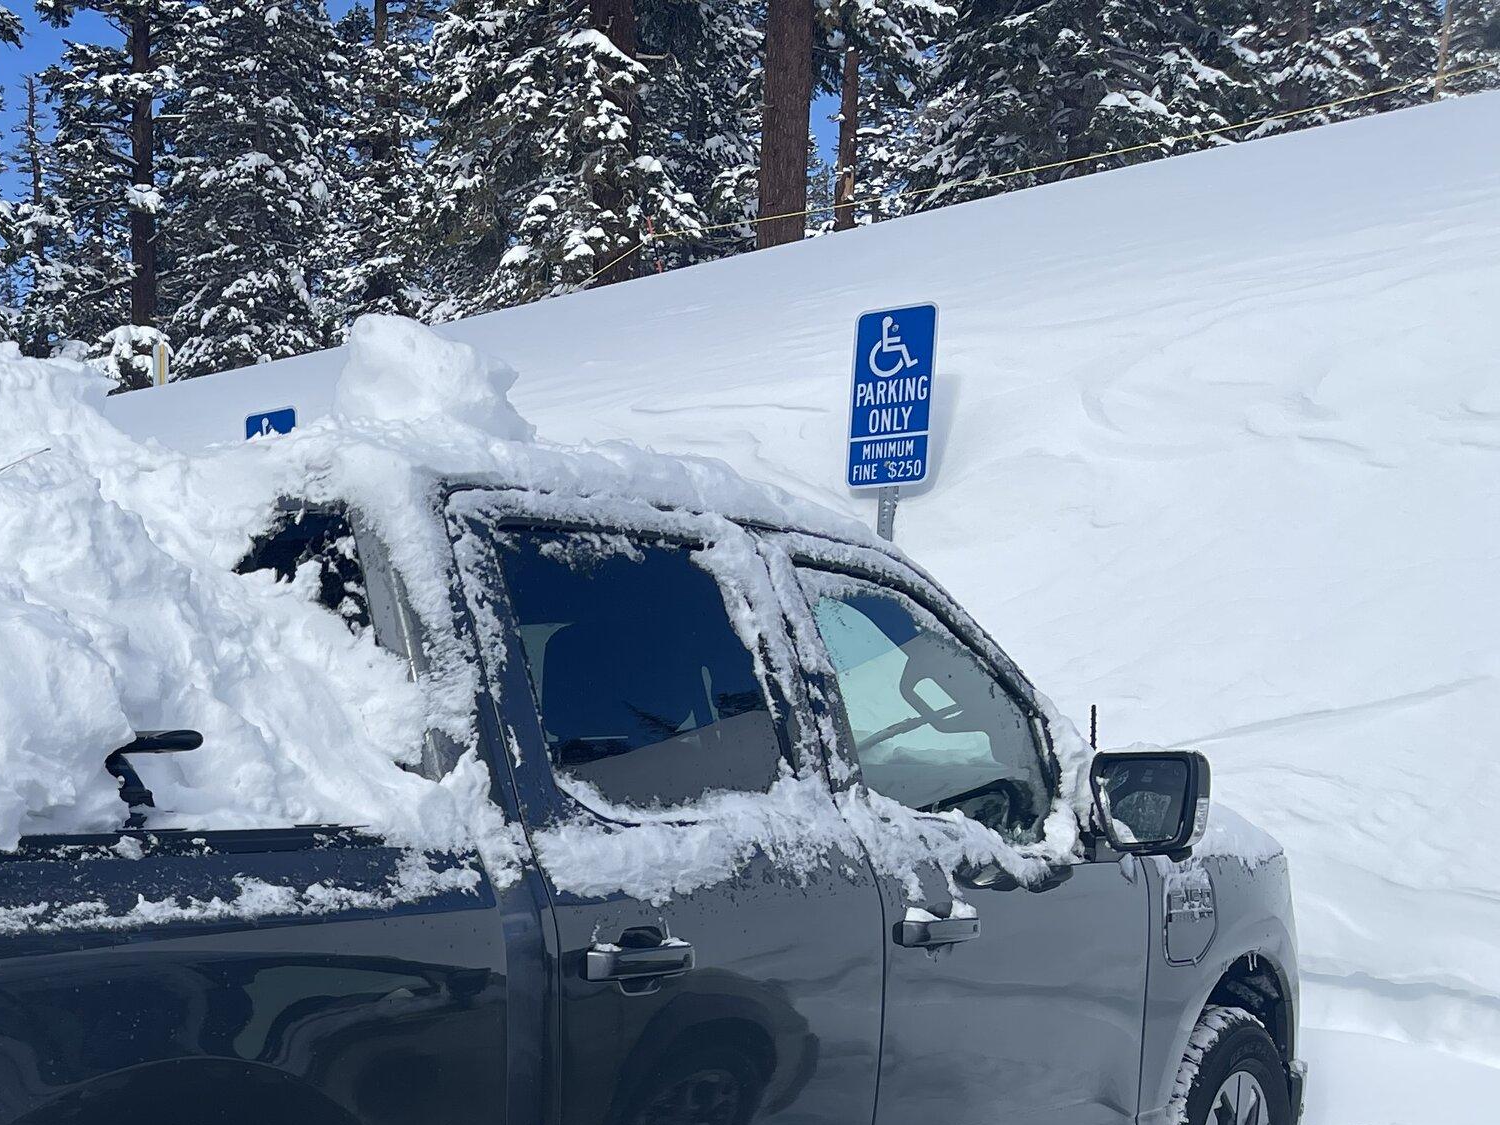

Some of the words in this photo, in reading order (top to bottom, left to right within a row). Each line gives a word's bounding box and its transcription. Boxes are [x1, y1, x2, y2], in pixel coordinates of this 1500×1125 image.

[856, 375, 928, 407] PARKING
[868, 407, 913, 434] ONLY
[862, 440, 914, 460] MINIMUM
[852, 463, 878, 482] FINE
[887, 459, 922, 480] $250
